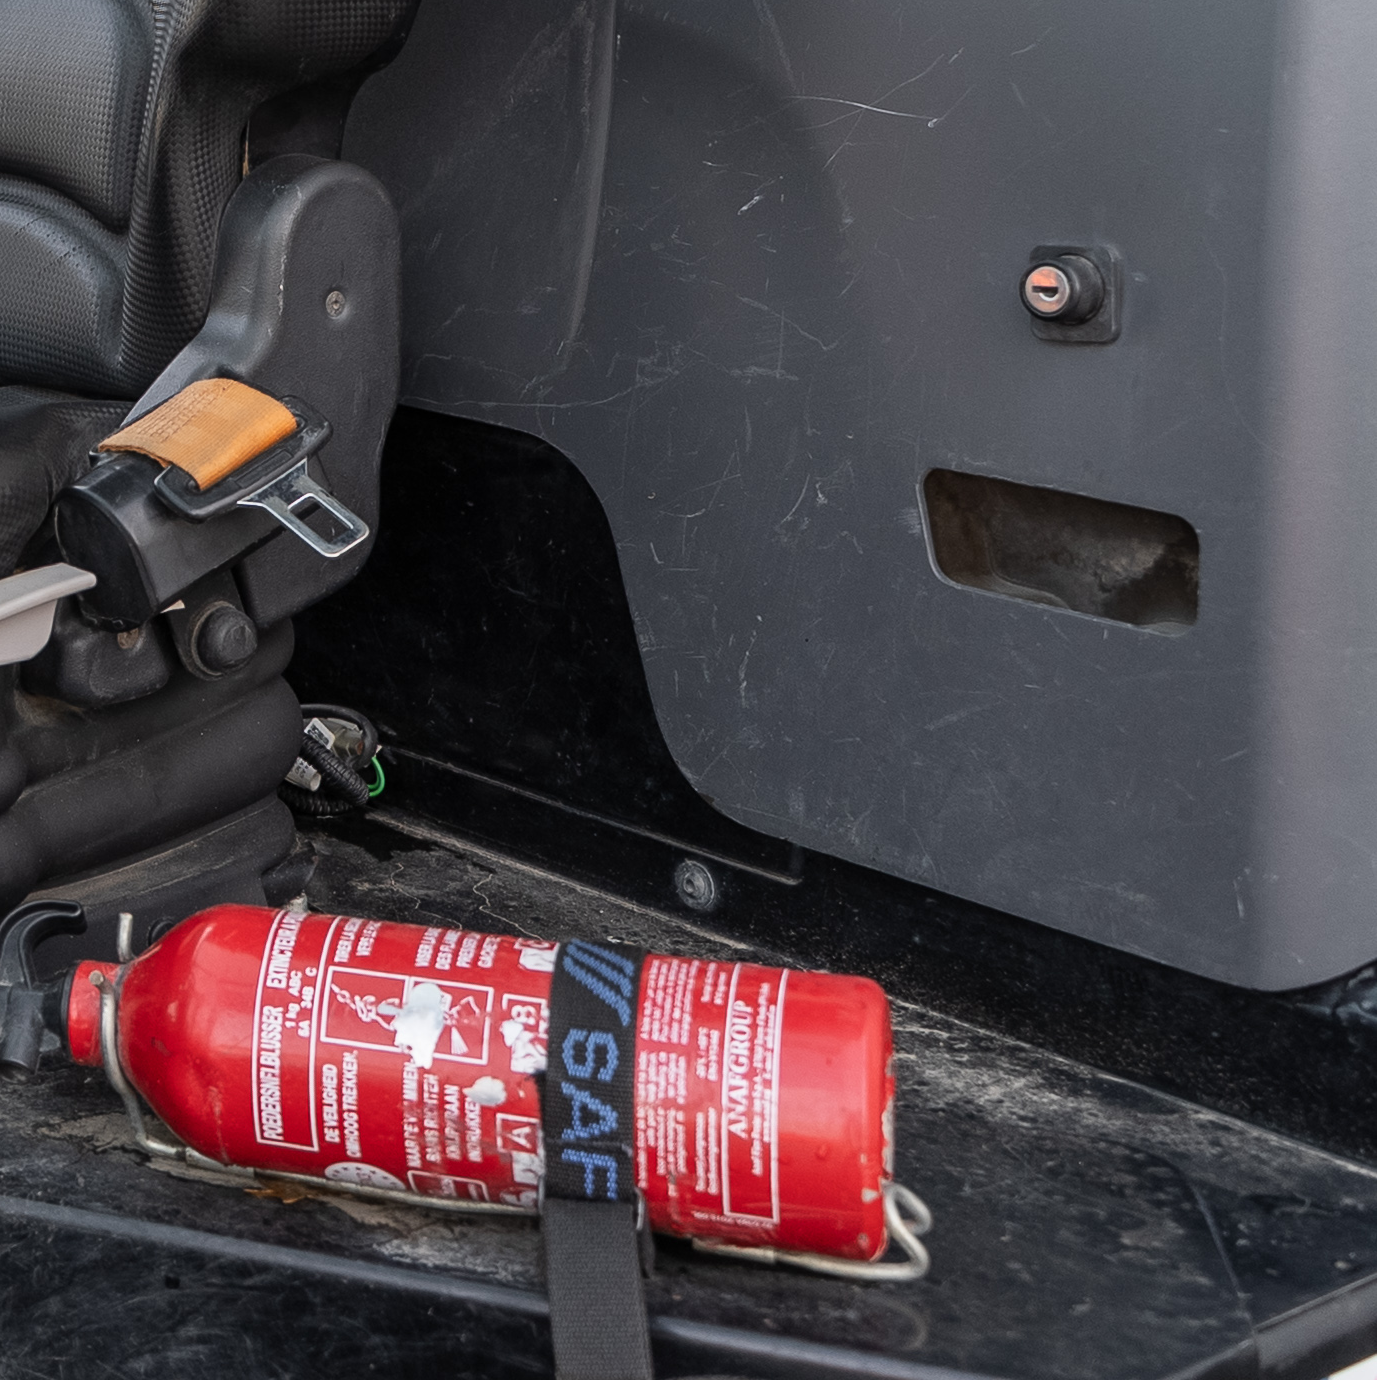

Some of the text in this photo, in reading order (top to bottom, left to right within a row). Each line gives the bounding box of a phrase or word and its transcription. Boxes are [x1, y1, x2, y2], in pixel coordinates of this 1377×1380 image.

[266, 928, 296, 989] EXTINCTEUR
[435, 952, 453, 970] DES
[288, 970, 302, 997] ABC
[305, 966, 318, 978] C
[301, 986, 315, 1010] 34B
[286, 1003, 300, 1020] kg
[727, 1000, 753, 1138] ANAFGROUP
[322, 1063, 340, 1143] DE VEILIGHEID
[343, 1111, 362, 1159] OMHOOG
[509, 1126, 532, 1149] A
